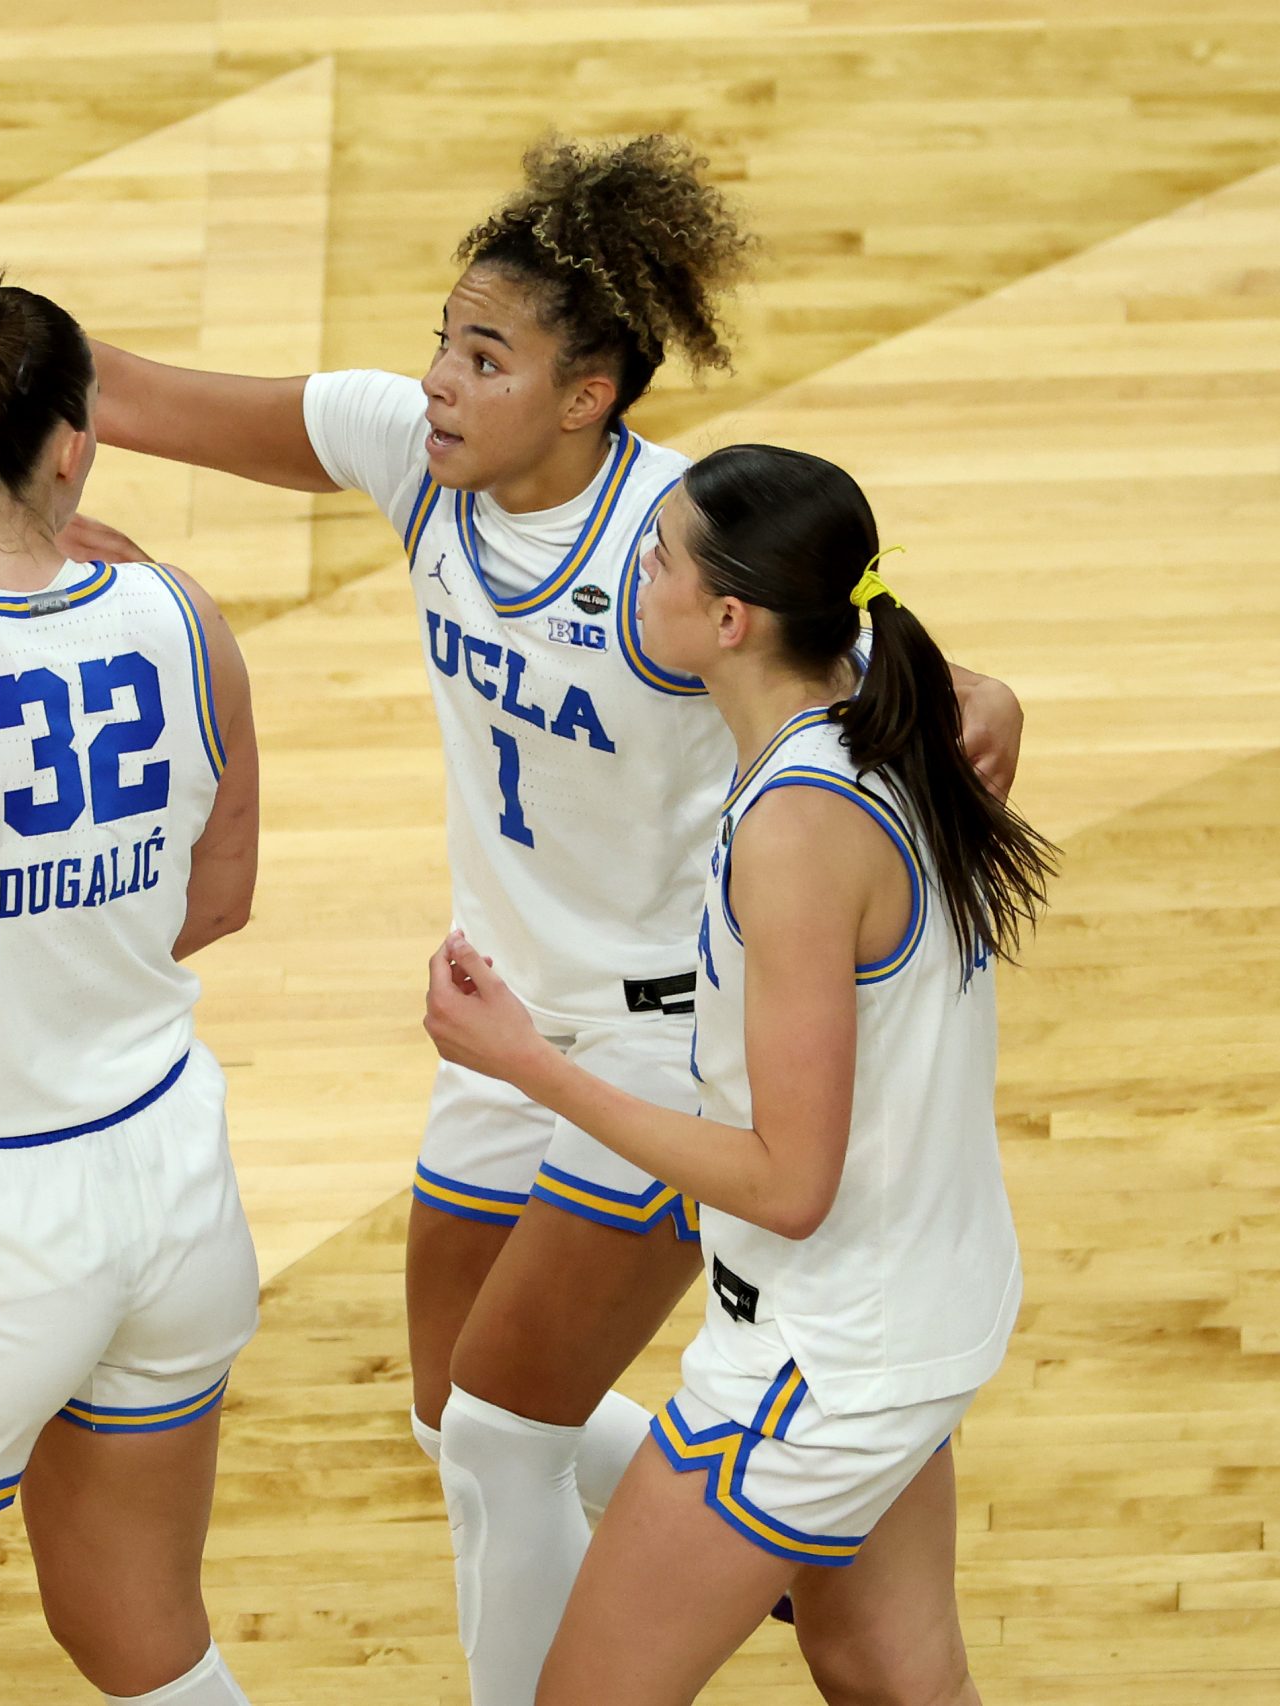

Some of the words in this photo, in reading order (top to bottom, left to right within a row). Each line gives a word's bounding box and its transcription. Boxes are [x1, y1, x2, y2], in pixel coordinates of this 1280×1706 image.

[574, 592, 591, 603] FINAL
[591, 595, 608, 606] FOUR
[426, 608, 616, 754] UCLA
[490, 725, 535, 849] 1
